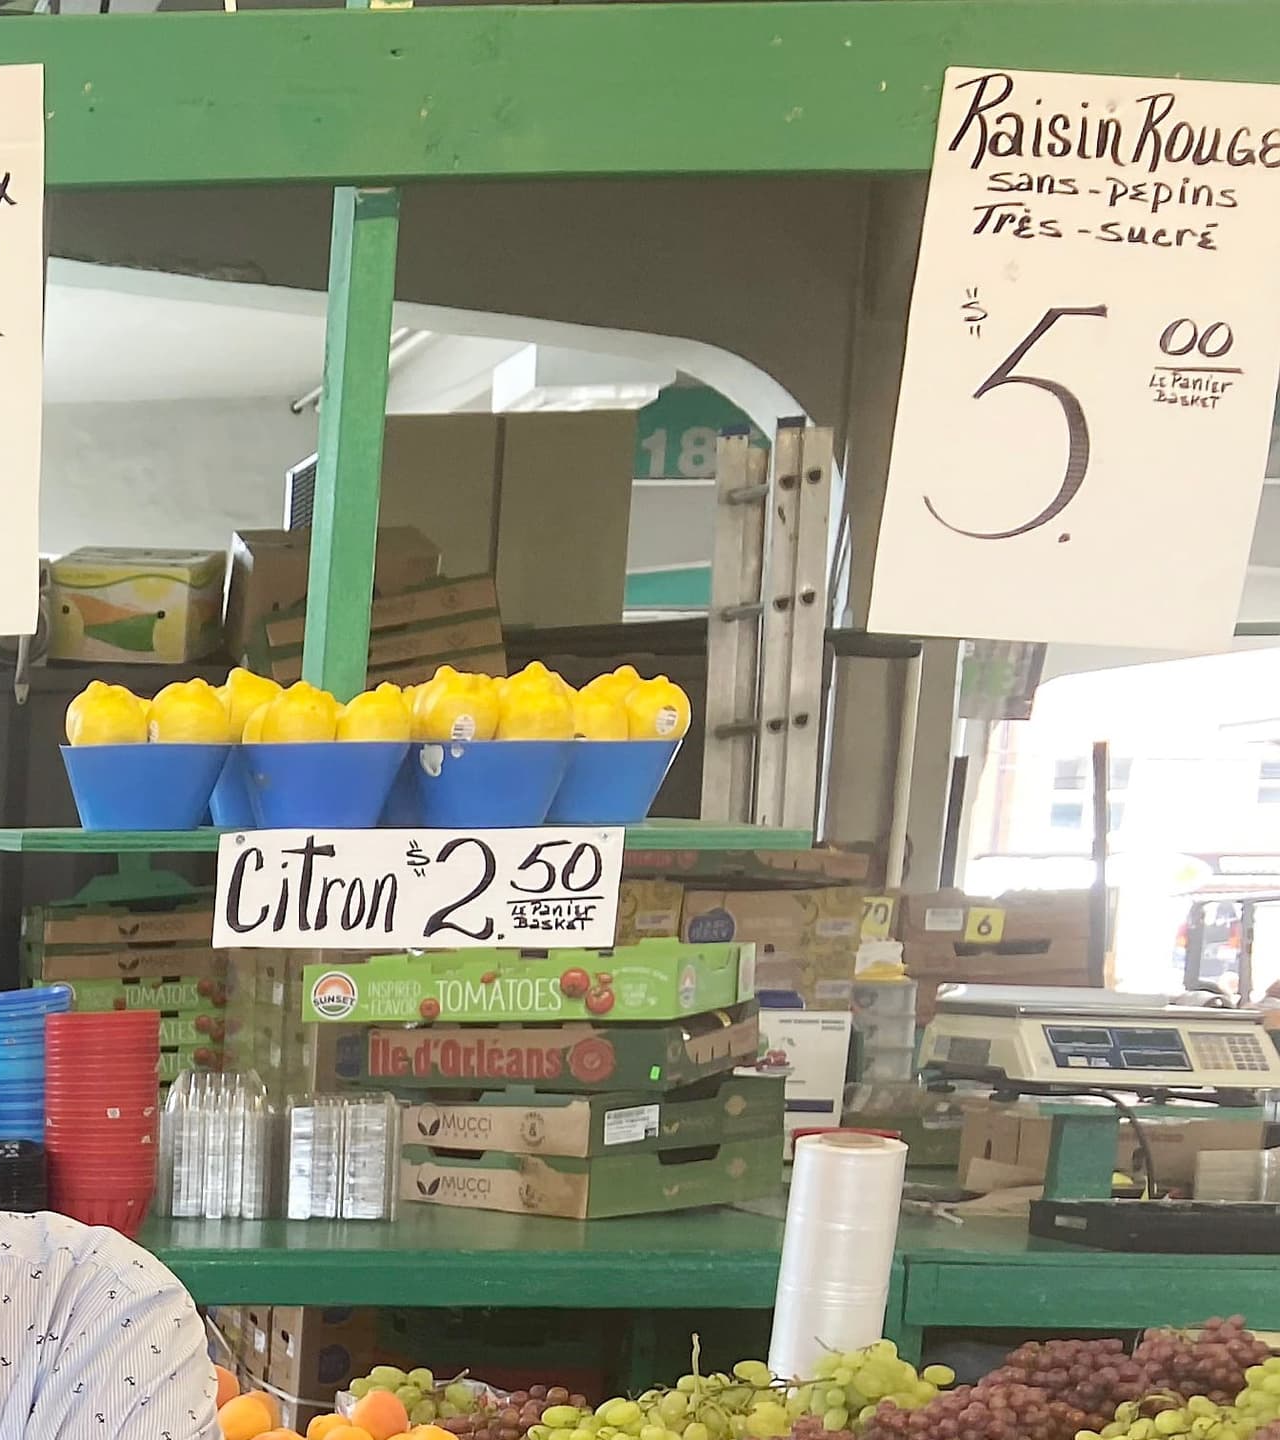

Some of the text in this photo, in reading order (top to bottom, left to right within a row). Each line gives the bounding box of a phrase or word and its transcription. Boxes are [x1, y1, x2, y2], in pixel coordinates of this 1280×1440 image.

[948, 72, 1125, 170] Raisin
[1159, 318, 1234, 358] 00
[641, 427, 718, 478] 18
[226, 836, 398, 934] Citron
[510, 840, 602, 893] 50
[977, 915, 992, 935] 6
[436, 978, 562, 1012] TOMATOES
